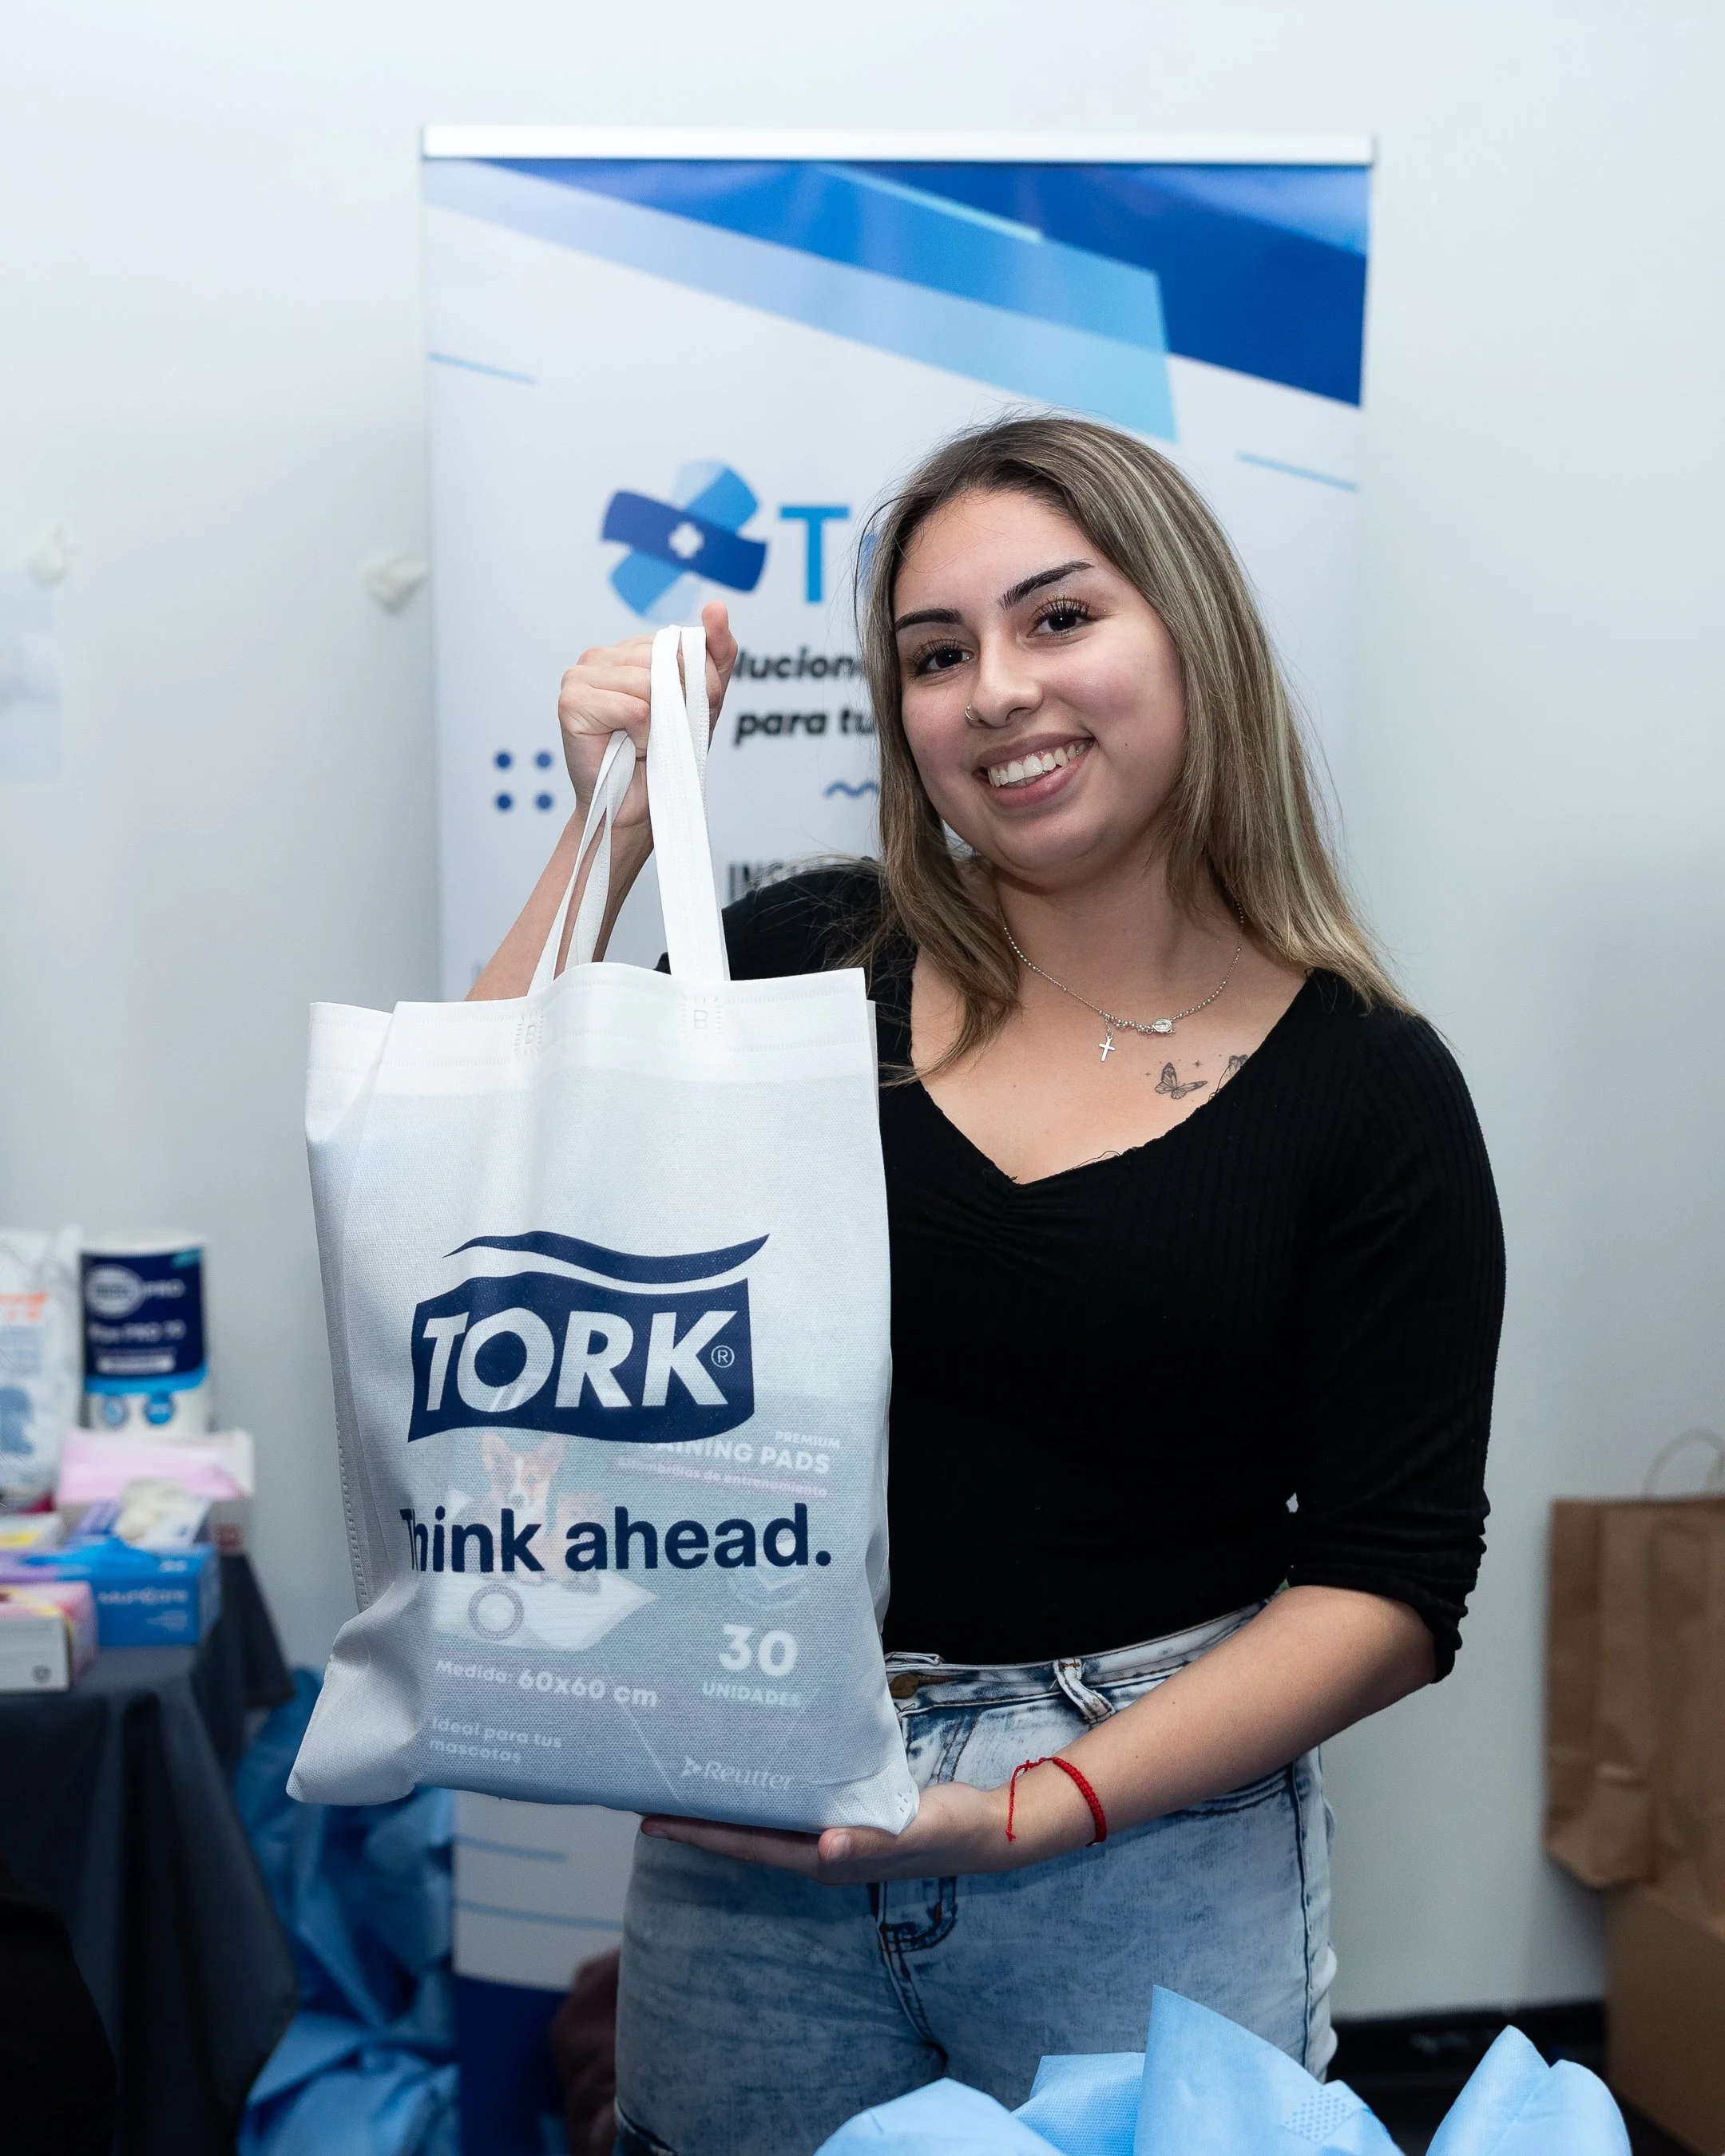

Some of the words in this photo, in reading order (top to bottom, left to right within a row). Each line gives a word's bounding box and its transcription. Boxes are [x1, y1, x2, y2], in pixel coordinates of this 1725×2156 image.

[733, 648, 865, 679] lucion
[733, 711, 828, 747] para
[775, 1431, 840, 1449] PREMIUM
[760, 1445, 831, 1473] PADS
[565, 1503, 832, 1571] ahead.
[718, 1623, 799, 1677] 30
[434, 1659, 513, 1684] Medida:
[518, 1668, 605, 1700] 60x60
[613, 1685, 658, 1707] cm
[701, 1680, 802, 1708] UNIDADES
[431, 1717, 480, 1736] Ideal
[483, 1726, 529, 1745] para
[533, 1732, 563, 1749] tus
[429, 1738, 522, 1763] mascotas
